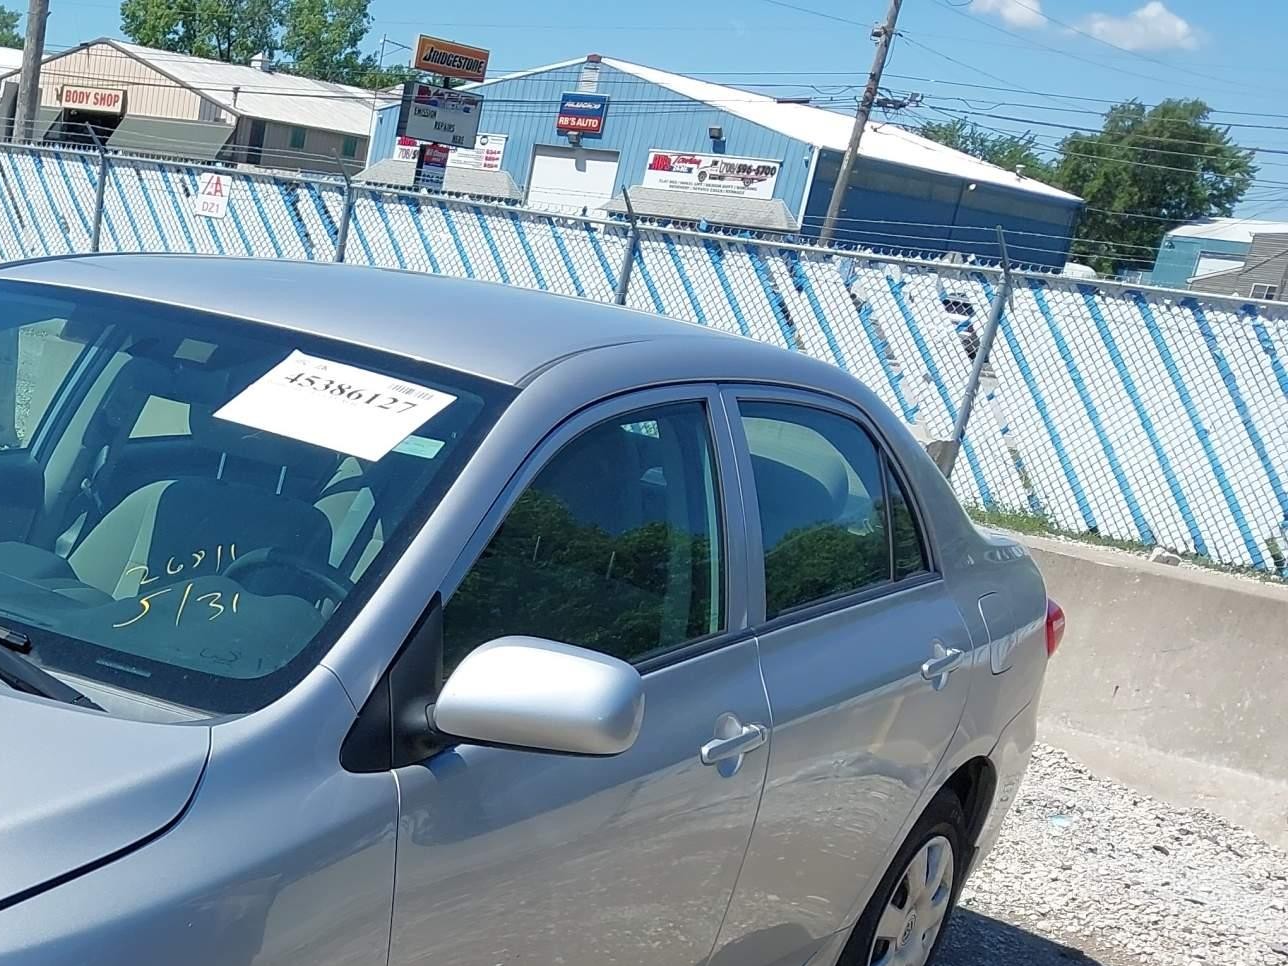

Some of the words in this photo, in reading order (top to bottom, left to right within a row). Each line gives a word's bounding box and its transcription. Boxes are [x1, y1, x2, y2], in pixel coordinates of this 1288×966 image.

[422, 46, 485, 73] BRIDGESTONE
[64, 90, 91, 104] BODY
[93, 92, 120, 107] SHOP
[576, 118, 599, 127] AUTO
[284, 372, 418, 414] 45386127
[112, 583, 240, 628] 5/31
